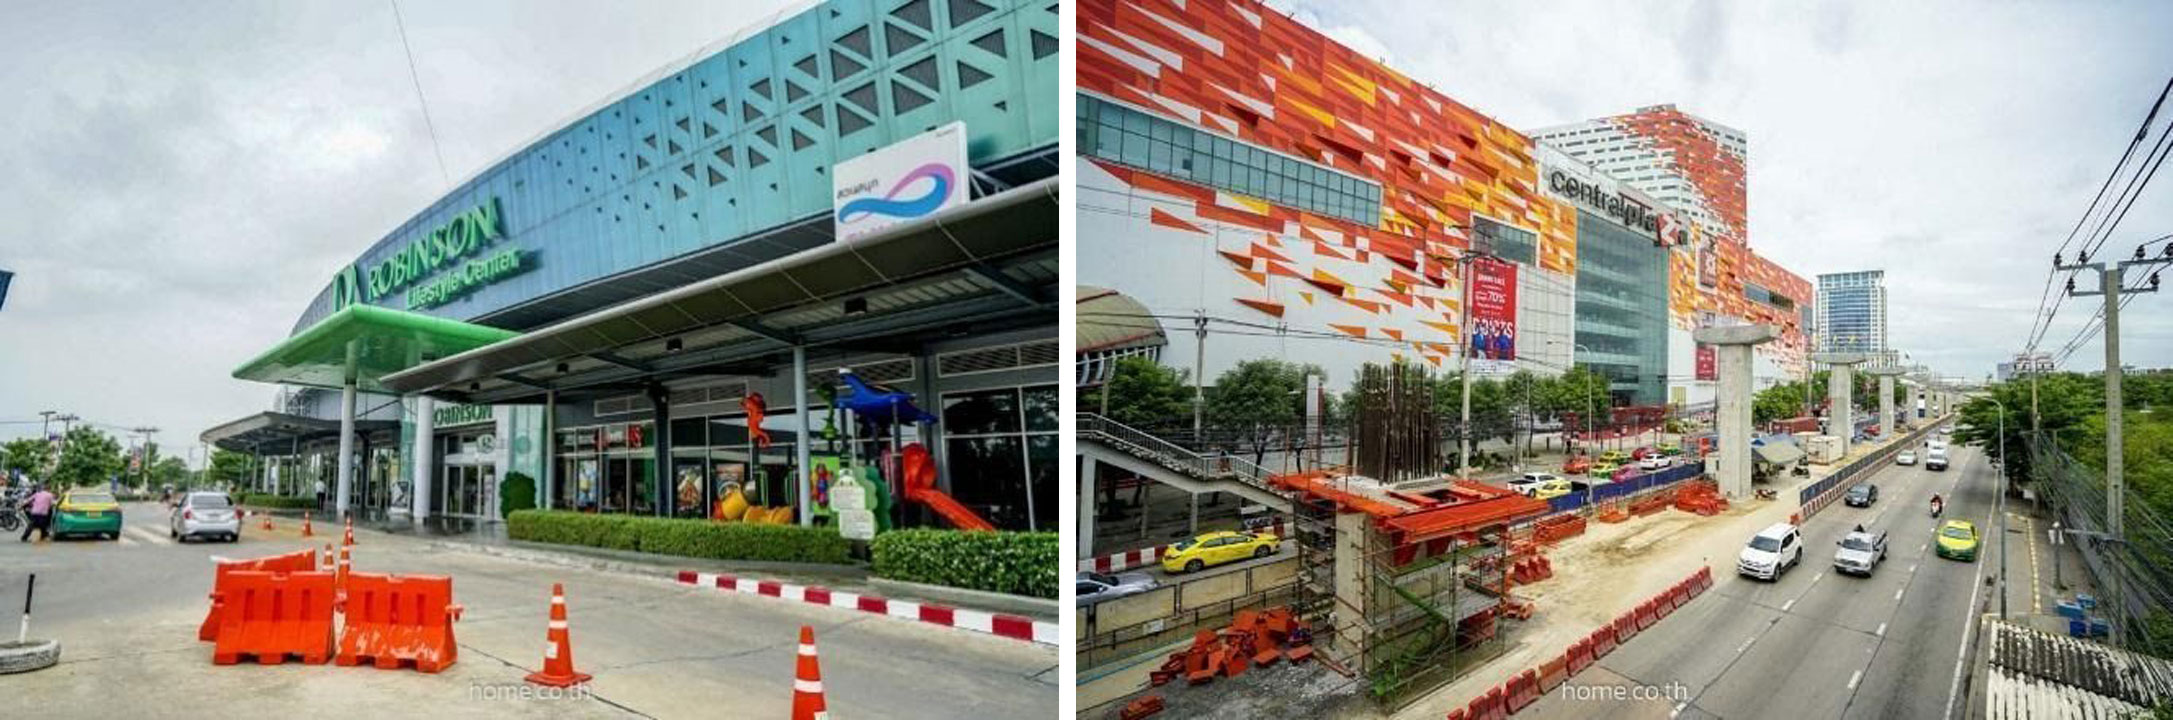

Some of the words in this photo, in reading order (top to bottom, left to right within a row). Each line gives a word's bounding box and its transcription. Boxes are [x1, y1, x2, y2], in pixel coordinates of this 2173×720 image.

[367, 196, 503, 303] ROBINSON
[406, 270, 459, 311] Lifestyle
[463, 247, 521, 285] Center
